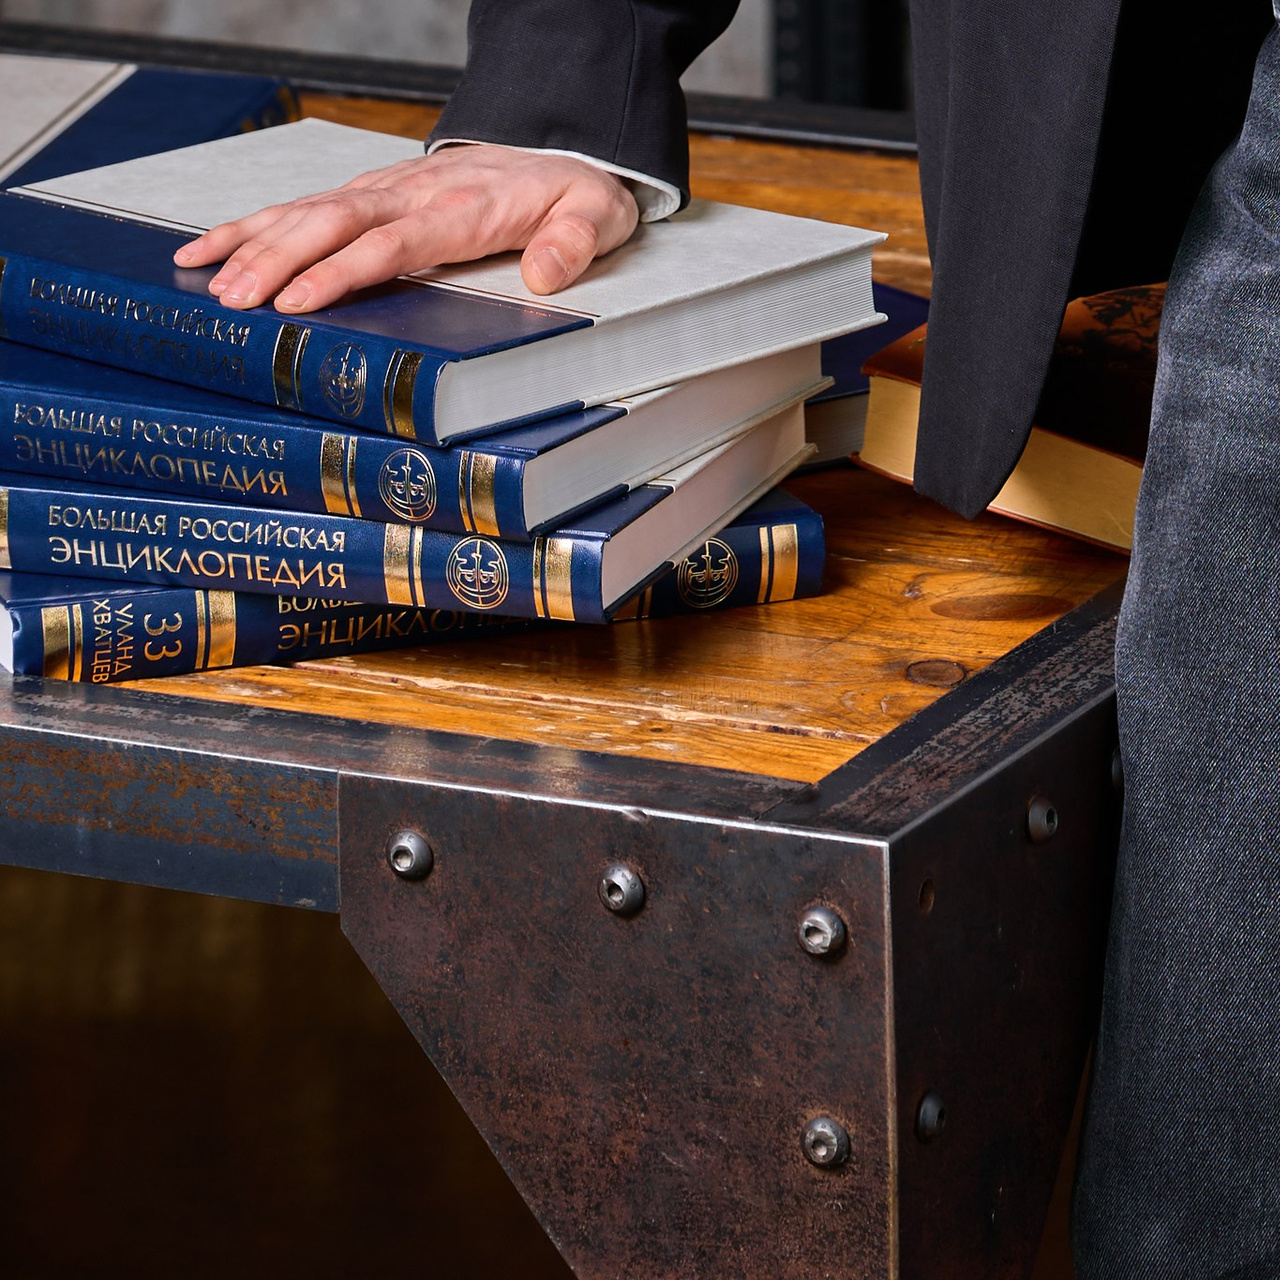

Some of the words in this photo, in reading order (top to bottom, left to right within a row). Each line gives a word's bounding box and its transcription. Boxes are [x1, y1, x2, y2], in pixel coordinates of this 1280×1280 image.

[29, 277, 118, 317] БОЛЬШАЯ
[124, 298, 251, 347] РОССИЙСКАЯ
[13, 402, 123, 438] БОЛЬШАЯ
[131, 418, 286, 461] РОССИЙСКАЯ
[13, 434, 288, 496] ЭНЦИКЛОПЕДИЯ
[48, 505, 167, 536] БОЛЬШАЯ
[178, 516, 346, 553] РОССИЙСКАЯ
[49, 536, 347, 590] ЭНЦИКЛОПЕДИЯ
[90, 598, 112, 684] ХВАТЦЕВ
[114, 602, 134, 676] УЛАНД
[143, 611, 183, 662] 33
